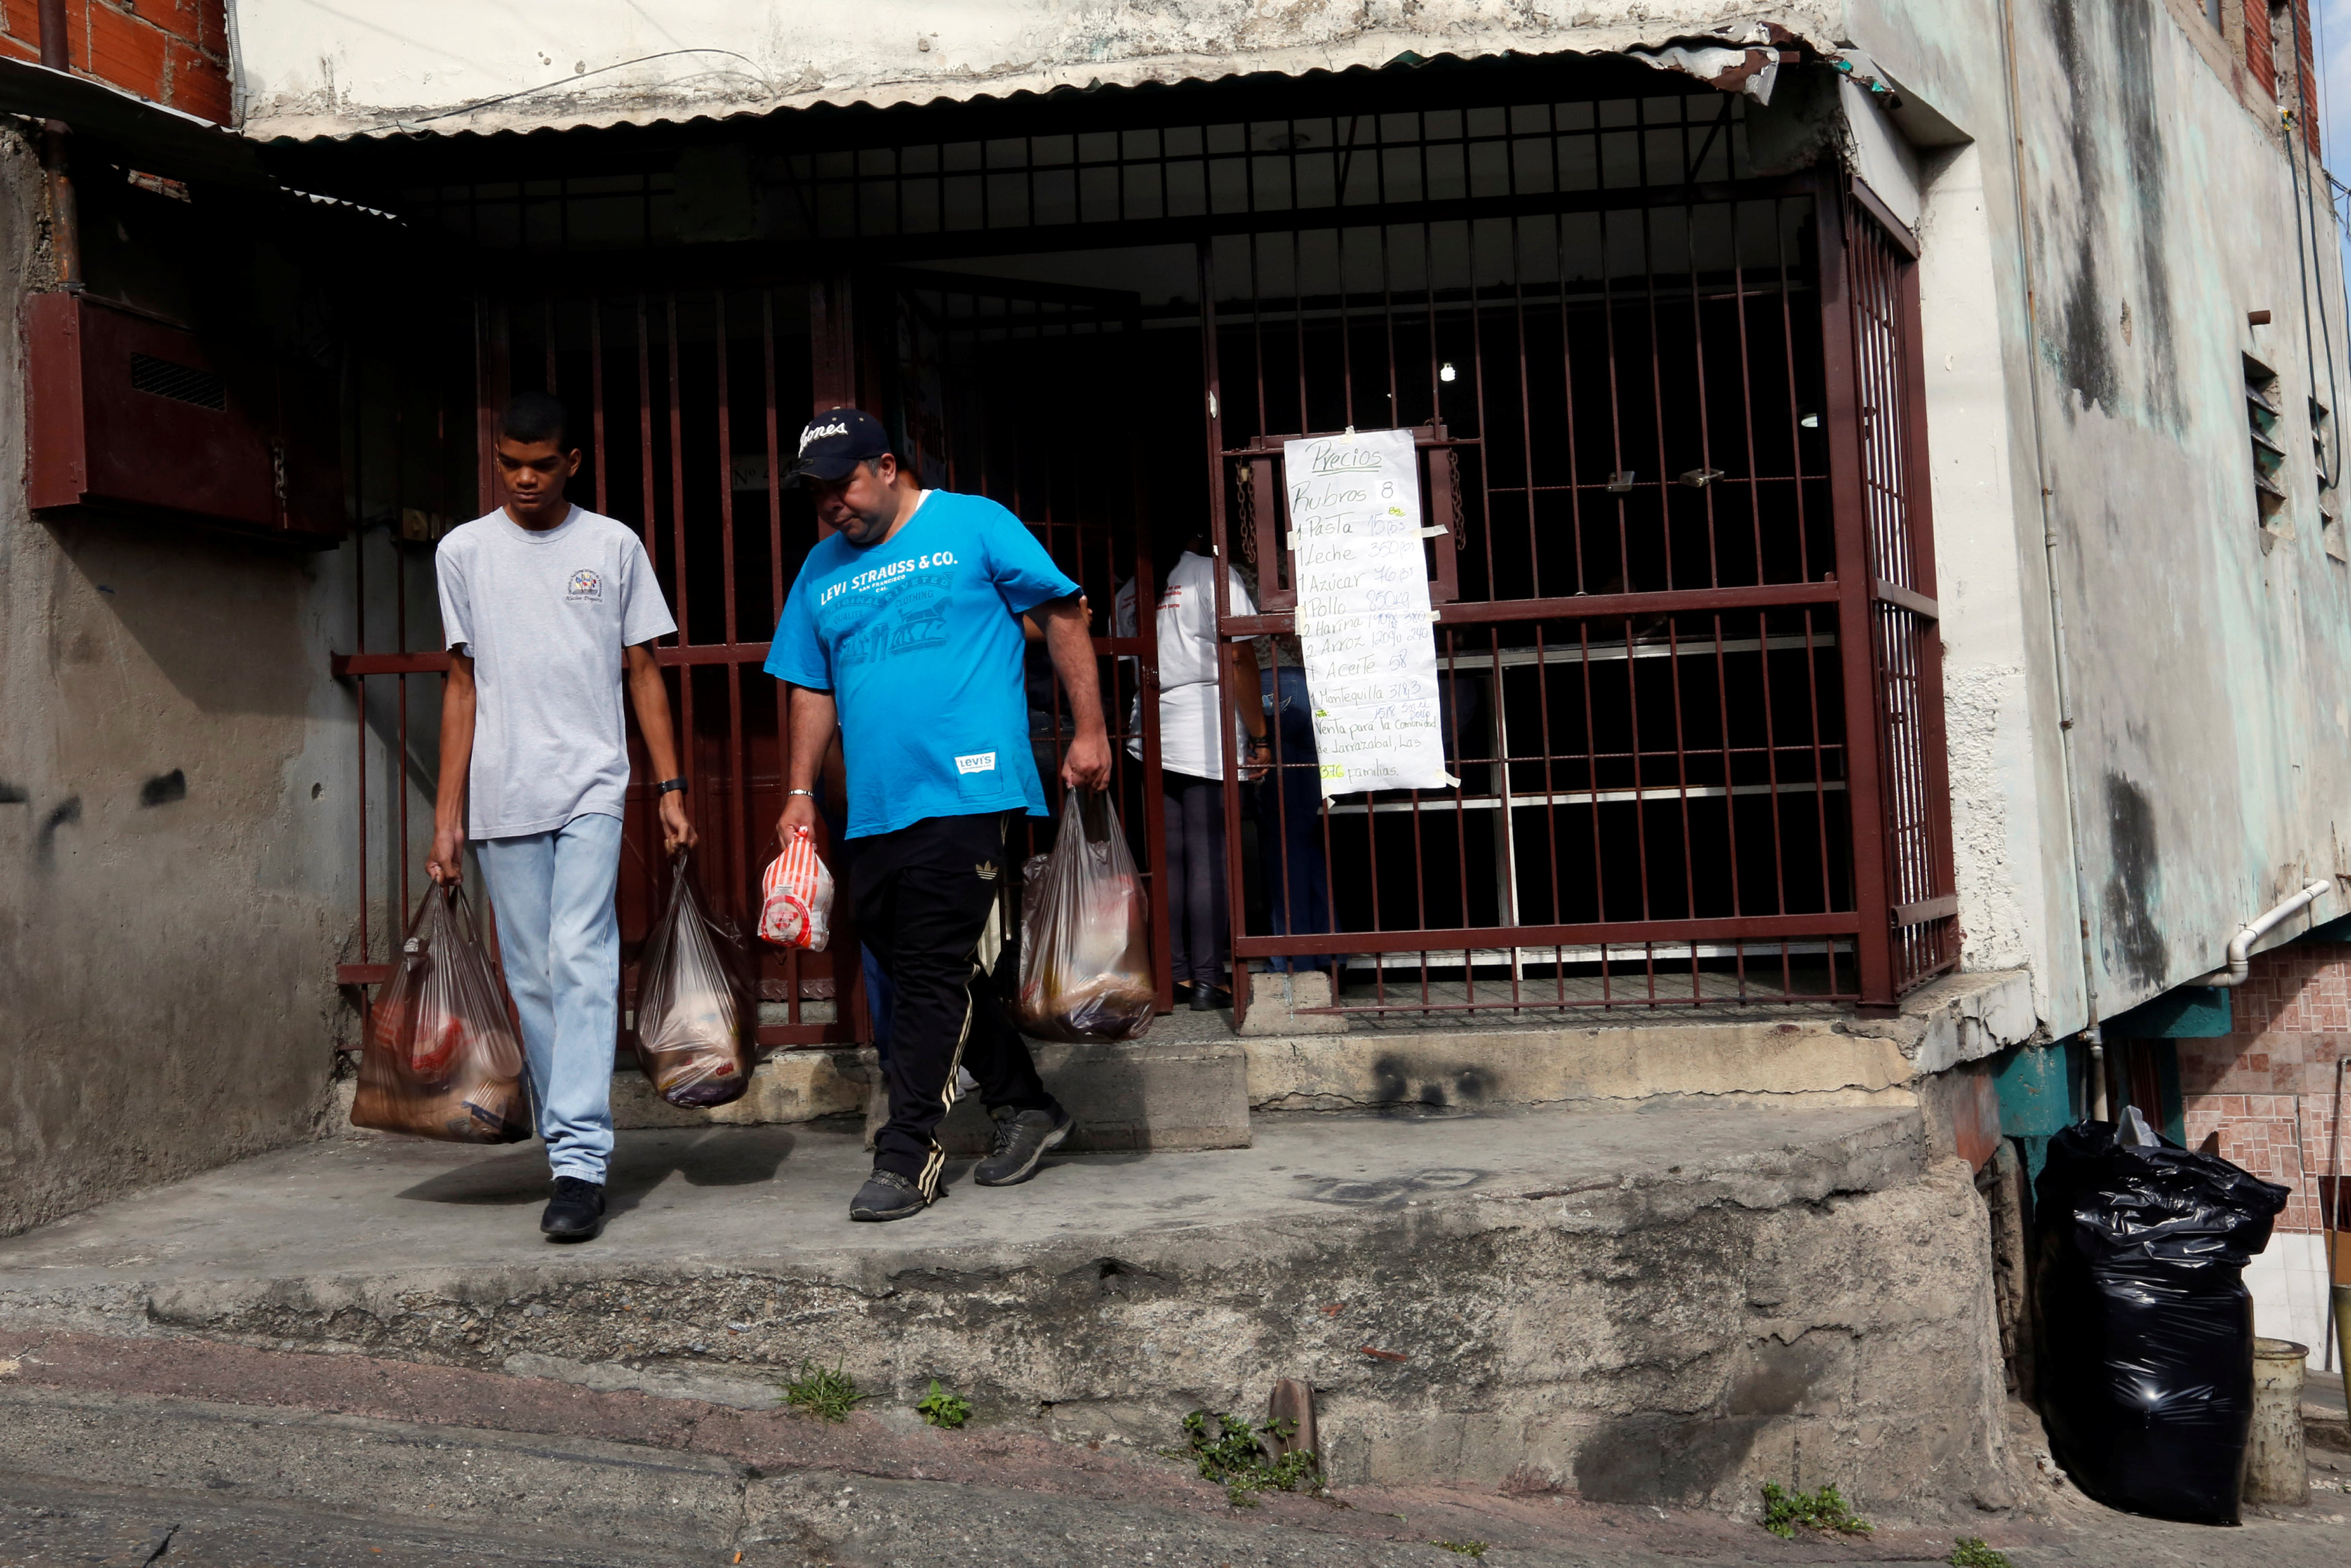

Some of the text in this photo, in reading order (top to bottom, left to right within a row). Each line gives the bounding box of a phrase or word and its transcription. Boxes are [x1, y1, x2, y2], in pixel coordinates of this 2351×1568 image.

[1305, 440, 1381, 470] Precios
[1291, 481, 1393, 513] Rubros 8
[1296, 524, 1302, 541] 1
[1297, 546, 1302, 566] 1
[1305, 544, 1356, 566] Leche
[821, 551, 958, 606] LEVI STRAUSS & CO.
[858, 574, 905, 592] SAN FRANCISCO
[885, 575, 948, 602] RIVETED
[1298, 573, 1304, 593] 1
[895, 590, 934, 608] CLOTHING
[1308, 596, 1346, 617] Pollo
[1301, 624, 1313, 638] 2
[1316, 618, 1363, 637] Harina
[1306, 645, 1317, 659] 2
[1321, 637, 1365, 655] Arroz
[1389, 649, 1407, 671] 58
[1310, 692, 1316, 706] 1
[1349, 723, 1374, 740] para
[1317, 741, 1329, 753] de
[1319, 764, 1344, 778] 376
